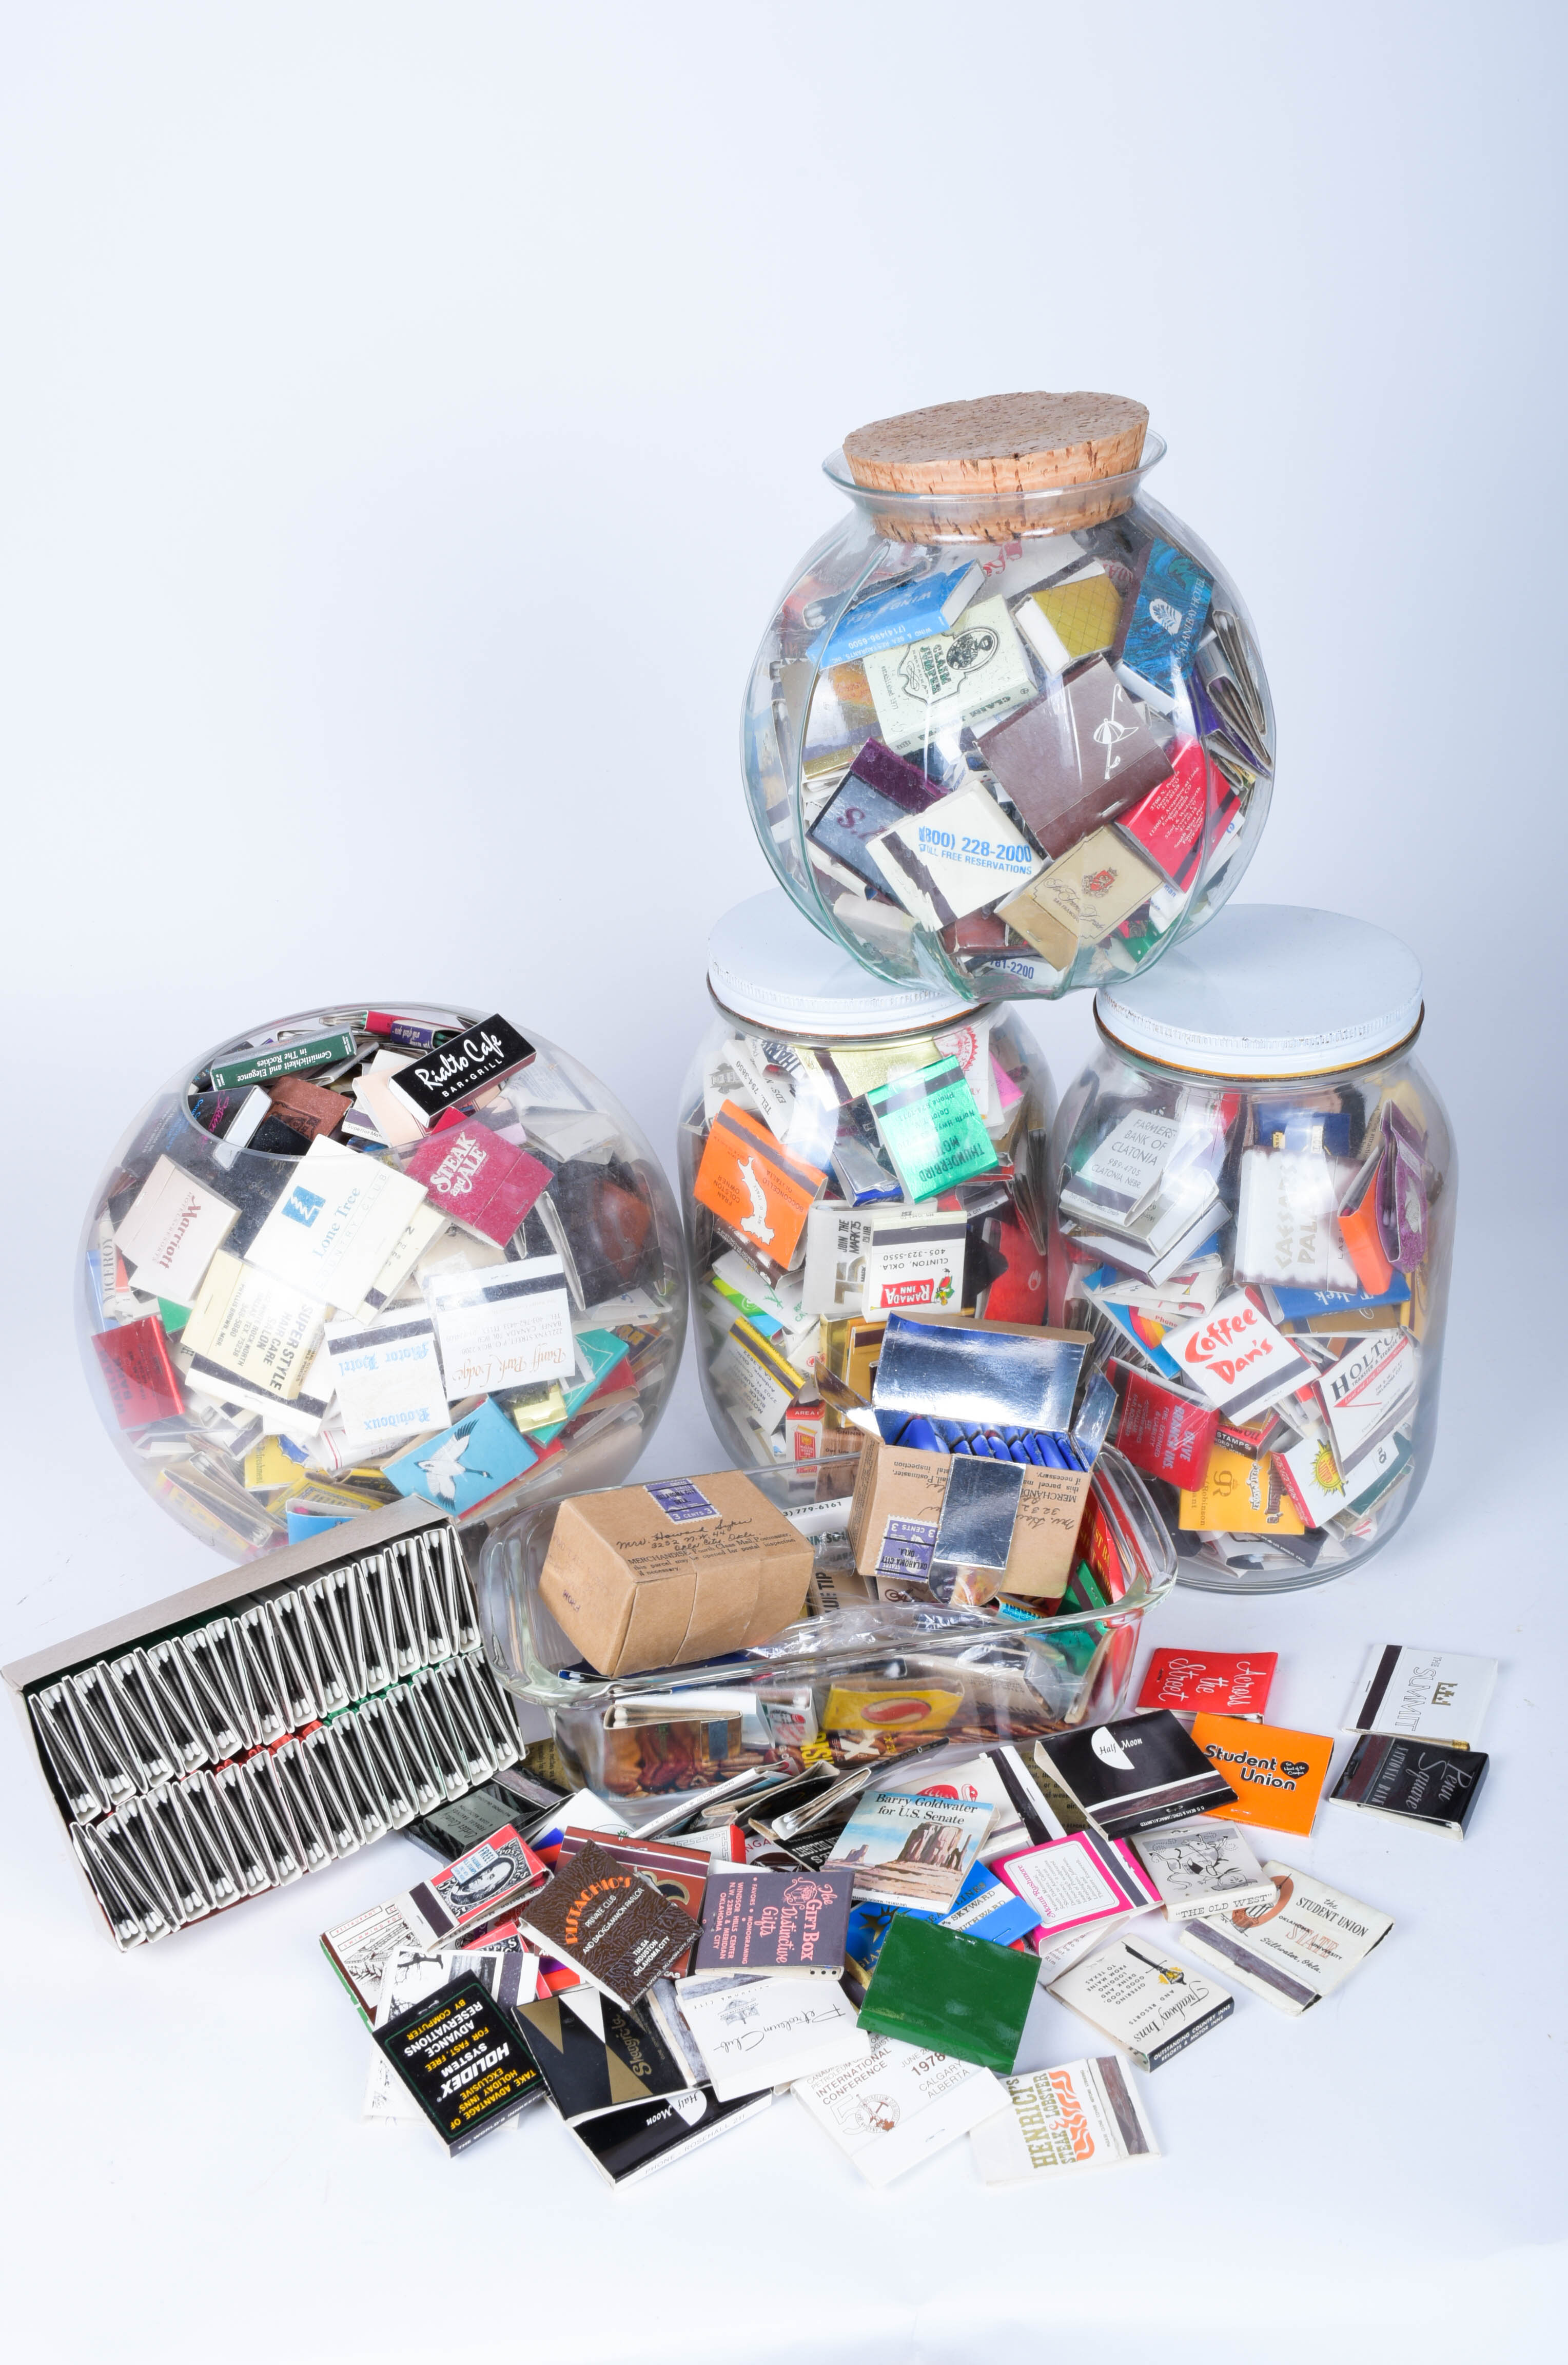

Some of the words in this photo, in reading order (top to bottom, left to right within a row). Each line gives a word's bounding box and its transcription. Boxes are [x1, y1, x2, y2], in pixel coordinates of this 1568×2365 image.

[1191, 577, 1205, 608] HOTEL
[920, 647, 941, 694] JUMPER
[933, 644, 951, 685] CLAIM
[881, 666, 894, 696] established
[969, 695, 1011, 717] CLAIM
[942, 850, 962, 862] FREE
[966, 855, 1032, 875] RESERVATIONS
[962, 837, 1032, 863] 228-2000
[257, 1055, 282, 1067] Rockies
[283, 1050, 332, 1071] Gemütlichkeit
[284, 1051, 298, 1060] The
[299, 1048, 307, 1057] in
[415, 1052, 468, 1091] Rialto
[465, 1031, 503, 1062] Cafe
[237, 1067, 268, 1082] Elegance
[269, 1064, 282, 1076] and
[736, 1061, 759, 1095] 794-3850
[761, 1104, 772, 1115] TEL.
[933, 1092, 955, 1107] Phone
[958, 1109, 975, 1123] North
[347, 1123, 369, 1136] Superior
[1124, 1130, 1148, 1146] BANK
[1151, 1139, 1168, 1152] OF
[1133, 1119, 1177, 1139] FARMERS
[429, 1132, 477, 1193] STEAK
[919, 1143, 985, 1182] THUNDERBIRD
[1111, 1141, 1159, 1166] CLATONIA
[713, 1179, 740, 1204] COLSTON
[718, 1175, 740, 1194] OWNER
[762, 1178, 804, 1212] BOCCONCELLO
[717, 1192, 733, 1207] FRAN
[160, 1195, 202, 1269] Marriott
[312, 1223, 340, 1258] Lone
[337, 1187, 361, 1222] Tree
[838, 1219, 849, 1233] THE
[838, 1235, 848, 1253] JOIN
[911, 1258, 948, 1267] CLINTON,
[884, 1284, 930, 1304] RAMADA
[900, 1286, 916, 1294] INN
[1185, 1308, 1258, 1364] Coffee
[238, 1344, 251, 1367] NORTH
[263, 1338, 281, 1366] CARE
[530, 1343, 566, 1373] Banff
[1205, 1338, 1273, 1385] Dan's
[269, 1348, 295, 1390] STYLE
[452, 1359, 492, 1389] Lodge
[489, 1354, 526, 1383] Park
[1351, 1364, 1374, 1387] TRANSFER
[1167, 1405, 1185, 1450] BRANCH
[1154, 1425, 1165, 1457] EXTENDED
[1180, 1430, 1195, 1462] OLIVE
[1217, 1431, 1251, 1450] STAMPS
[894, 1461, 931, 1471] inspection
[1036, 1472, 1073, 1482] necessary.
[928, 1528, 936, 1538] 3
[651, 1560, 672, 1568] parcel
[764, 1538, 796, 1547] inspection
[693, 1546, 714, 1554] Fourth
[880, 1556, 898, 1564] CITY
[898, 1548, 915, 1557] OKLA.
[900, 1559, 928, 1569] OKLAHOMA
[816, 1572, 834, 1590] TIP
[1159, 1657, 1207, 1702] Street
[1194, 1675, 1230, 1694] the
[1227, 1660, 1259, 1708] Across
[1395, 1666, 1437, 1732] SUMMIT
[1099, 1742, 1117, 1756] Half
[1121, 1737, 1143, 1751] Moon
[1204, 1744, 1278, 1771] Student
[1381, 1746, 1408, 1783] NATIONAL
[1240, 1767, 1296, 1791] Union
[1406, 1752, 1437, 1810] Square
[1437, 1754, 1476, 1801] Penn
[875, 1793, 913, 1807] Barry
[914, 1797, 978, 1814] Goldwater
[878, 1806, 894, 1815] for
[897, 1807, 920, 1818] U.S.
[923, 1811, 964, 1825] Senate
[478, 1846, 495, 1864] FREE!
[1017, 1864, 1040, 1896] Rushmore
[734, 1882, 744, 1912] WINDSOR
[749, 1884, 757, 1906] FAVORS
[818, 1884, 837, 1905] The
[951, 1890, 995, 1922] SKYWARD
[955, 1882, 987, 1907] LINES
[1038, 1895, 1056, 1918] Mount
[1323, 1898, 1339, 1910] the
[585, 1907, 605, 1928] PRIVATE
[603, 1895, 616, 1909] CLUB
[593, 1904, 627, 1943] BACKGAMMON
[624, 1888, 644, 1909] PARLOR
[804, 1899, 822, 1930] GIFT
[1208, 1902, 1228, 1913] OLD
[1296, 1897, 1335, 1923] STUDENT
[1337, 1918, 1369, 1937] UNION
[754, 1906, 779, 1938] Gifts
[1279, 1915, 1309, 1933] OKLAHOMA
[632, 1939, 650, 1956] TULSA
[719, 1928, 730, 1960] MERIDIAN
[728, 1935, 737, 1959] CENTER
[776, 1906, 798, 1964] Distinctive
[800, 1931, 820, 1961] BOX
[1285, 1925, 1340, 1960] STATE
[634, 1947, 660, 1976] OKLAHOMA
[659, 1936, 671, 1950] CITY
[635, 1940, 658, 1965] HOUSTON
[1260, 1937, 1300, 1963] Stillwater,
[1301, 1959, 1322, 1974] Okla.
[1311, 1942, 1343, 1961] UNIVERSITY
[1085, 1971, 1106, 1984] TEXAS
[1098, 1972, 1127, 1992] LODGING
[1110, 1965, 1127, 1977] FROM
[1125, 1975, 1145, 1990] GOOD
[1087, 1977, 1107, 1992] MAINE
[1115, 1983, 1145, 2005] OFFERING
[1129, 2003, 1157, 2025] RESORTS
[1159, 1981, 1209, 2026] Treadway
[404, 2002, 483, 2057] RESERVATIONS
[406, 2009, 451, 2041] COMPUTER
[764, 2003, 846, 2033] Petroleum
[425, 2020, 475, 2058] ADVANCE
[713, 2030, 766, 2053] Club
[1134, 2020, 1161, 2043] Inns
[1153, 2032, 1190, 2061] OUTSTANDING
[1191, 2014, 1217, 2033] COUNTRY
[1218, 2004, 1231, 2015] INNS
[440, 2042, 510, 2099] HOLIDEX
[441, 2043, 487, 2078] SYSTEM
[816, 2048, 892, 2098] INTERNATIONAL
[901, 2054, 920, 2068] JUNE
[911, 2052, 946, 2076] 1978
[460, 2068, 504, 2100] EXCLUSIVE
[483, 2069, 518, 2096] HOLIDAY
[514, 2069, 537, 2087] TAKE
[822, 2060, 888, 2105] CONFERENCE
[919, 2059, 963, 2091] CALGARY
[928, 2069, 970, 2099] ALBERTA
[463, 2084, 511, 2120] ADVANTAGE
[678, 2091, 698, 2110] Half
[1033, 2073, 1061, 2116] LOBSTER
[450, 2118, 461, 2130] OF
[646, 2105, 672, 2127] Moon
[1052, 2130, 1078, 2164] STEAK
